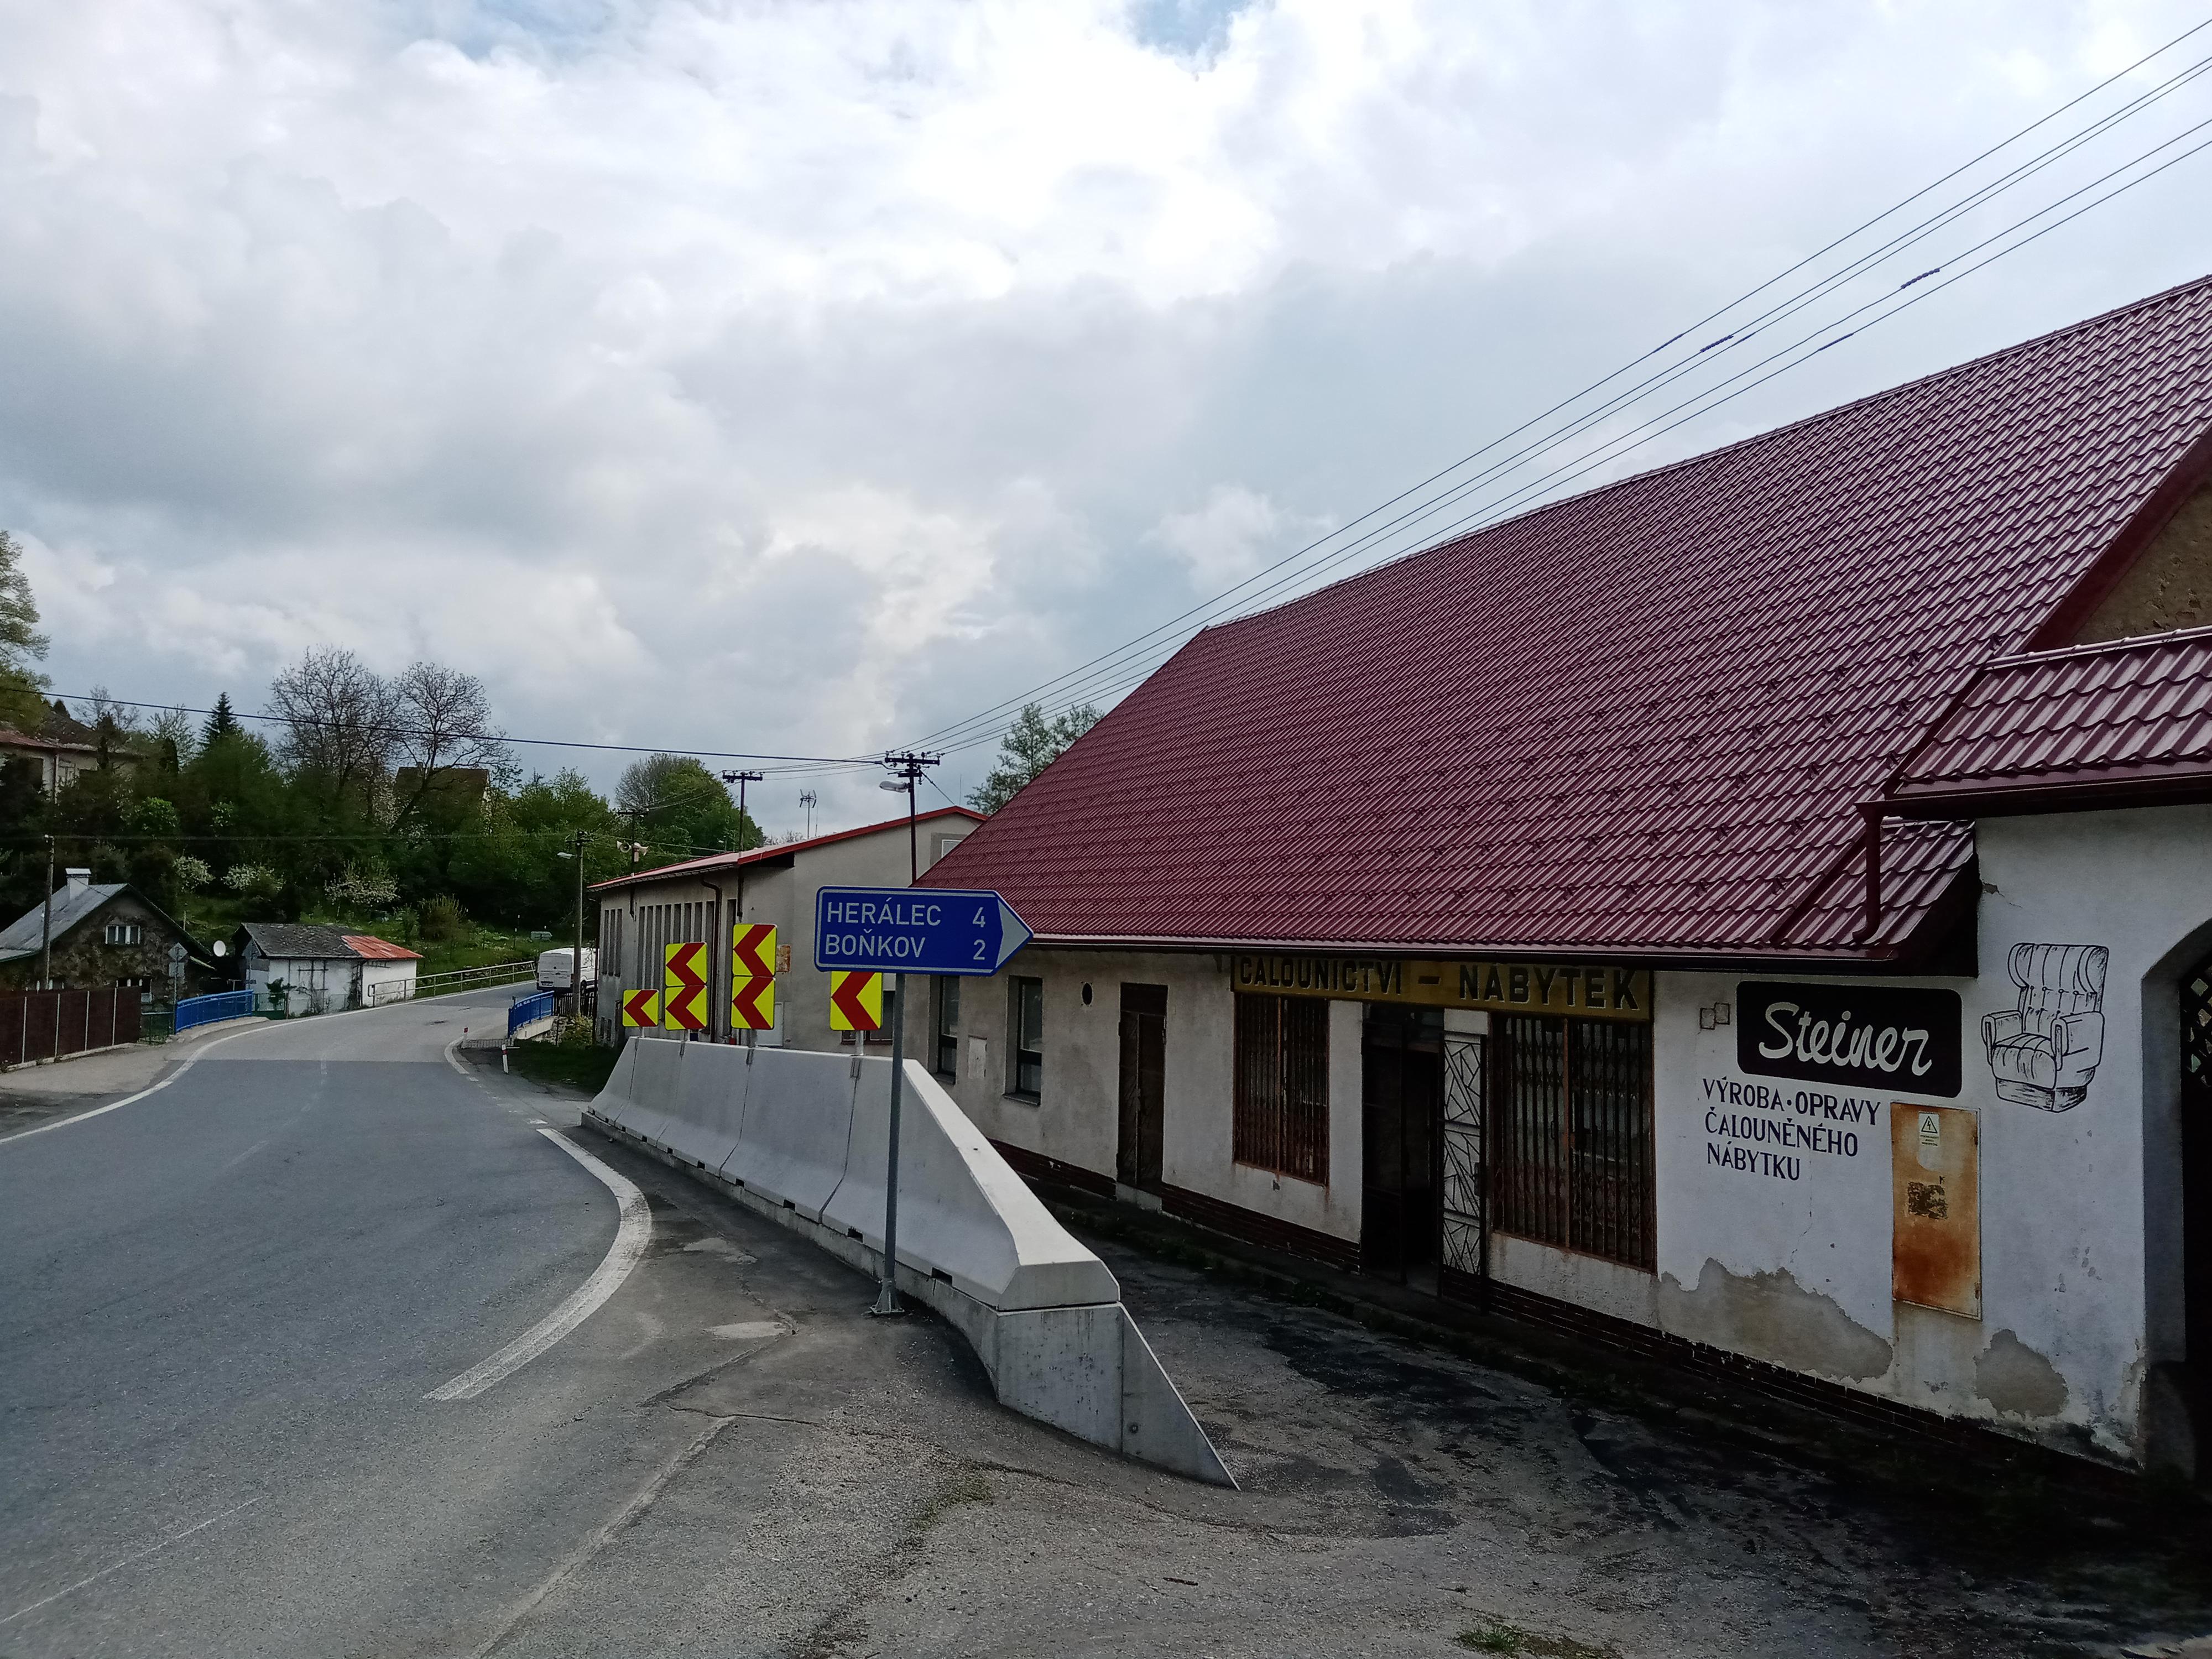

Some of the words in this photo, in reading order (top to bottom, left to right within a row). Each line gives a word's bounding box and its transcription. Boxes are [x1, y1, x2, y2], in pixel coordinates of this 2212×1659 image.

[827, 896, 942, 926] HERÁLEC
[972, 907, 986, 928] 4
[825, 928, 926, 958] BOŇKOV
[972, 940, 986, 961] 2
[1759, 1001, 1933, 1077] Steiner
[1794, 1090, 1881, 1125] OPRAVY
[1705, 1107, 1859, 1157] ČALOUNĚNÉHO
[1707, 1141, 1801, 1181] NÁBYTKU
